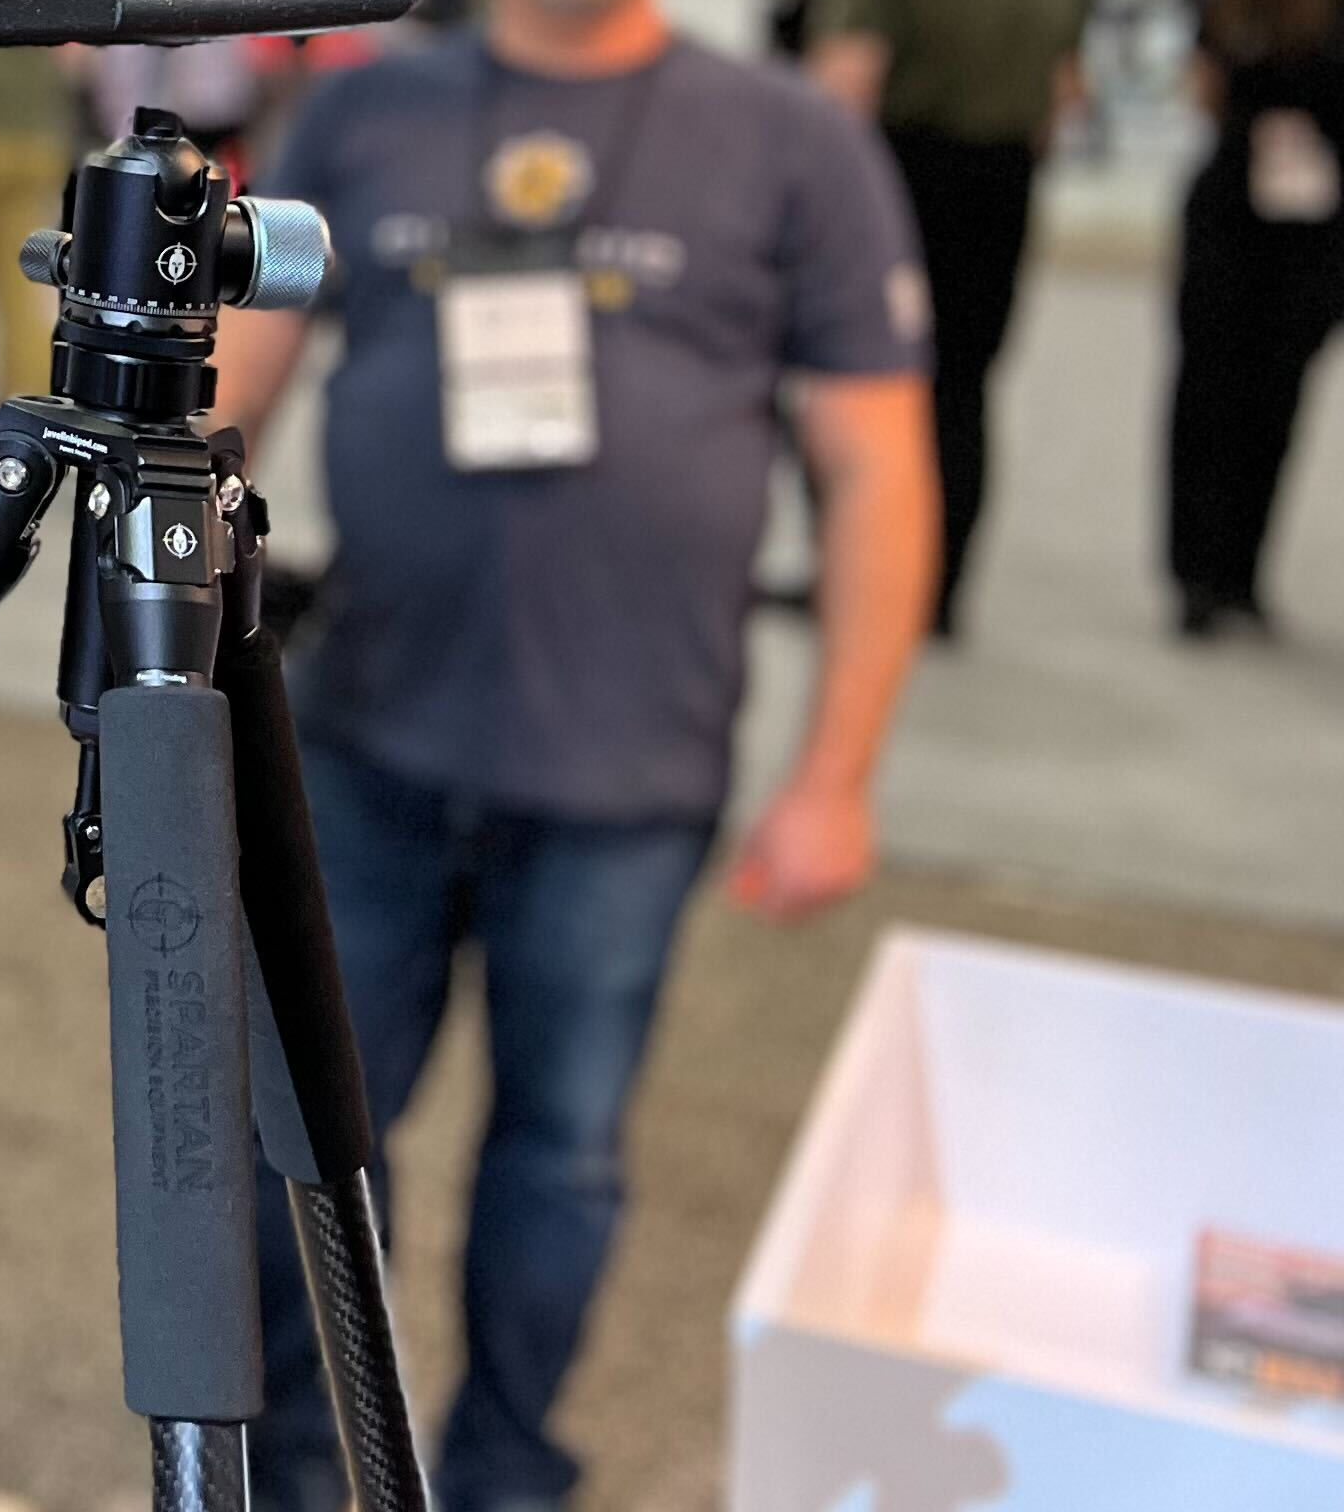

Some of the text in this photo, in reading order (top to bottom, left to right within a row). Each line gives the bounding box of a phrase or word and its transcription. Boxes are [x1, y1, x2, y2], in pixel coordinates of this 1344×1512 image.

[42, 426, 108, 454] javelinbipod.com
[144, 968, 169, 1192] PRECISION EQUIPMENT
[168, 969, 214, 1192] SPARTAN
